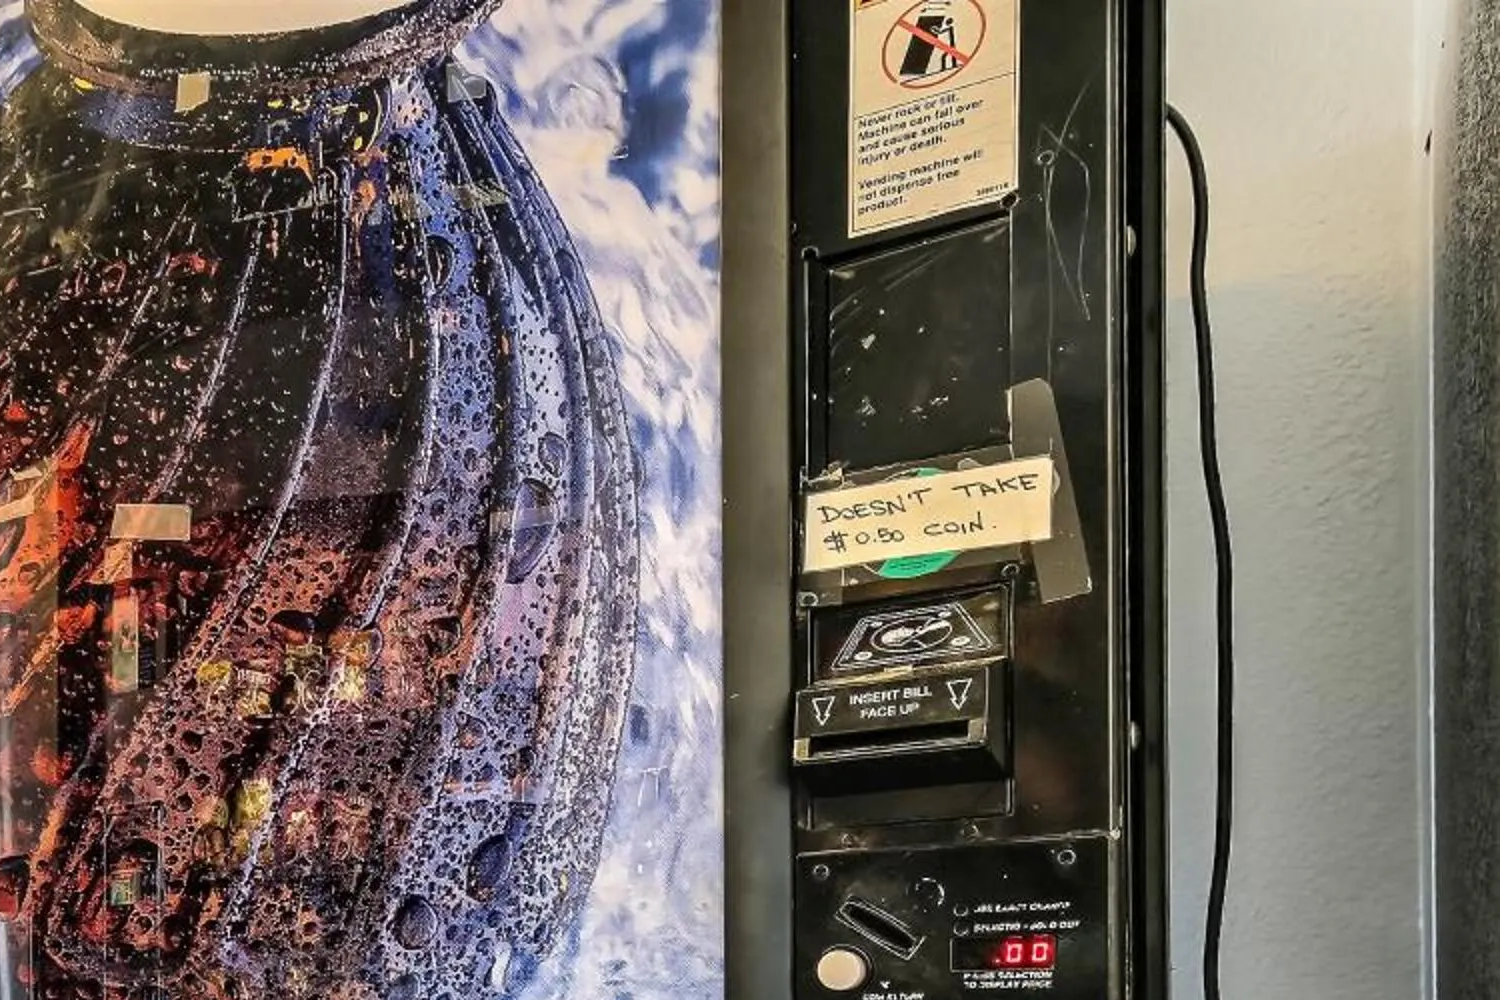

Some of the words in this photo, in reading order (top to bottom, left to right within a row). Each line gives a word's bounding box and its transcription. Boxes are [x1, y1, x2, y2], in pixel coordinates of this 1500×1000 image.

[858, 113, 891, 128] Never
[895, 105, 920, 118] rock
[923, 100, 937, 111] or
[858, 121, 906, 140] Machine
[910, 115, 931, 126] can
[935, 107, 953, 120] fall
[956, 100, 984, 113] over
[858, 140, 880, 152] and
[883, 131, 917, 146] cause
[921, 118, 965, 134] serious
[858, 150, 890, 167] injury
[894, 145, 907, 156] or
[858, 170, 906, 189] Vending
[910, 157, 960, 175] machine
[879, 175, 933, 199] dispense
[937, 169, 960, 181] free
[818, 487, 933, 525] DOESN'T
[951, 473, 1039, 499] TAKE
[849, 689, 900, 706] INSERT
[903, 685, 933, 699] BILL
[860, 704, 898, 720] FACE
[899, 702, 921, 717] UP
